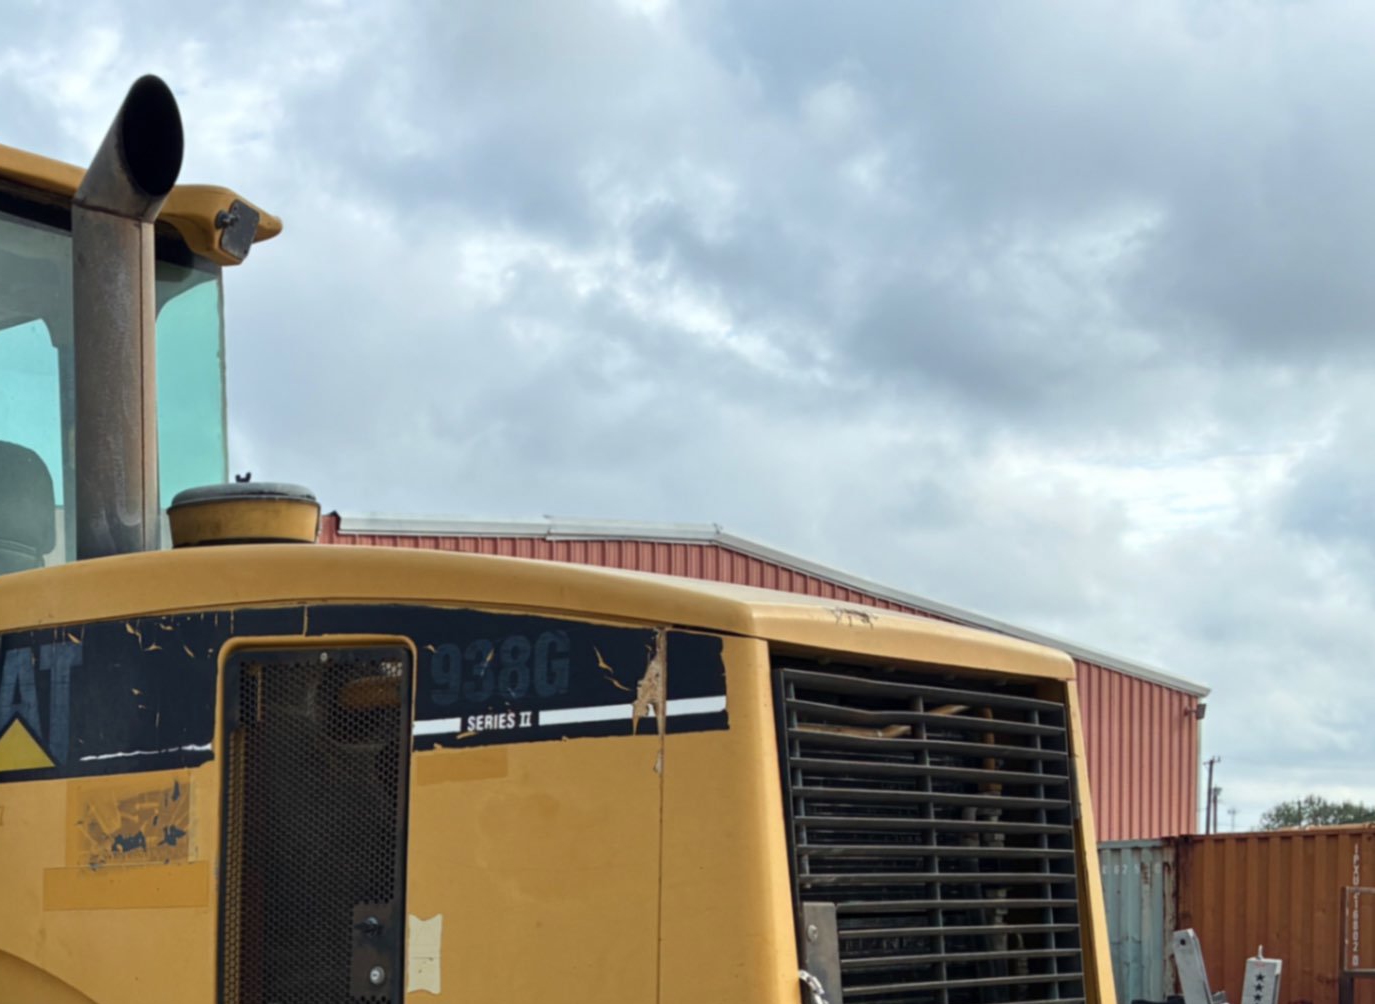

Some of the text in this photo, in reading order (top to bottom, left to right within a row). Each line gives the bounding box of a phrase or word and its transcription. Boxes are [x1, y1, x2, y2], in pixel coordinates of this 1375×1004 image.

[430, 629, 572, 706] 938G
[467, 710, 532, 733] SERIES II
